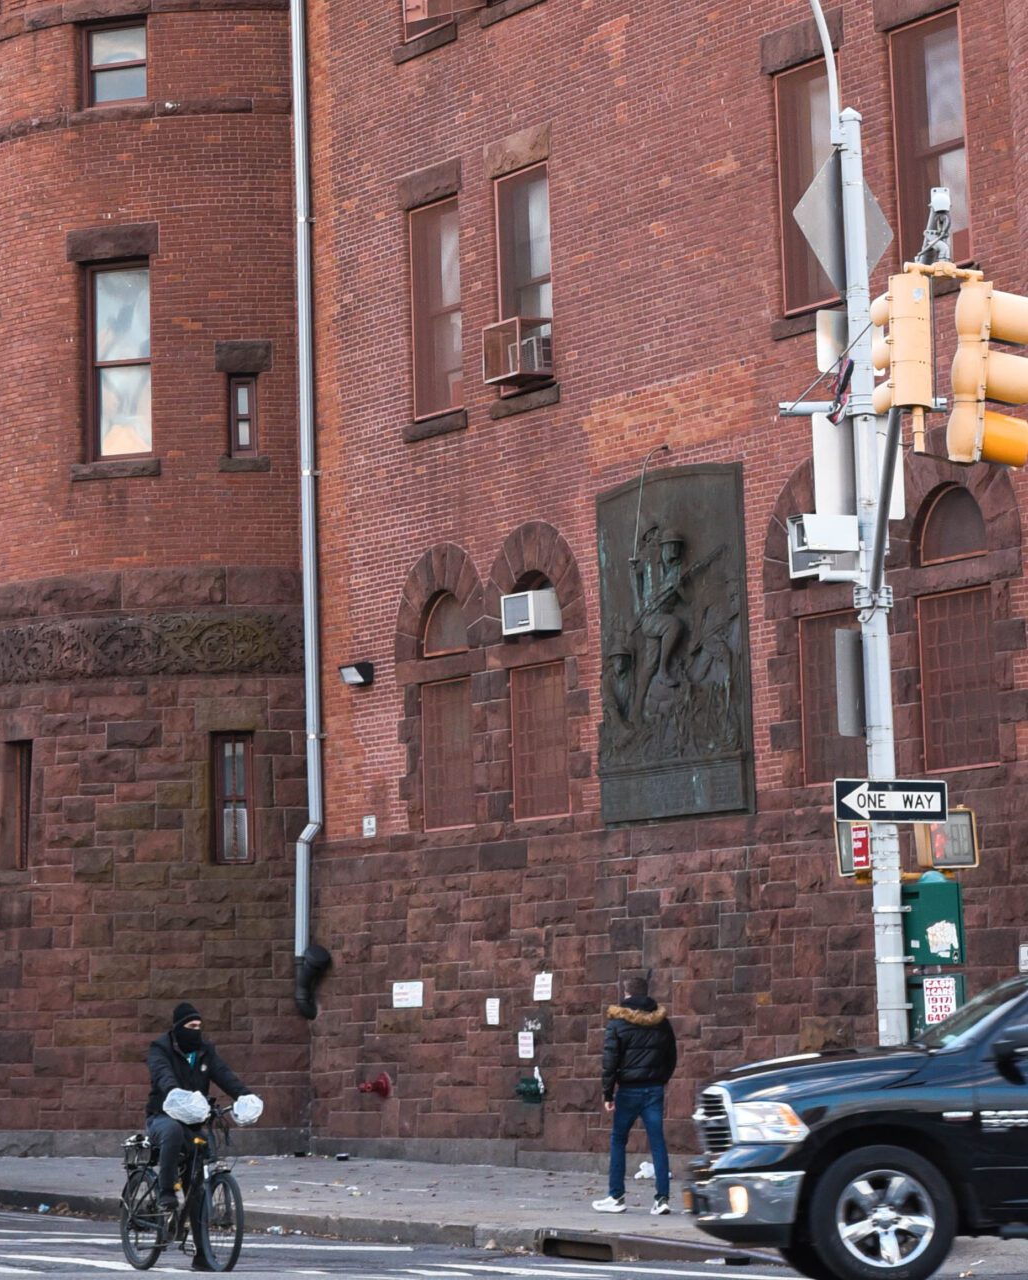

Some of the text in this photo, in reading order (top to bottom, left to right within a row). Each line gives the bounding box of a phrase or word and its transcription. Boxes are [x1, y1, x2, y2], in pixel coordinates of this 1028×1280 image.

[857, 793, 934, 809] ONE WAY
[925, 979, 954, 987] CASH
[931, 1005, 951, 1013] 515
